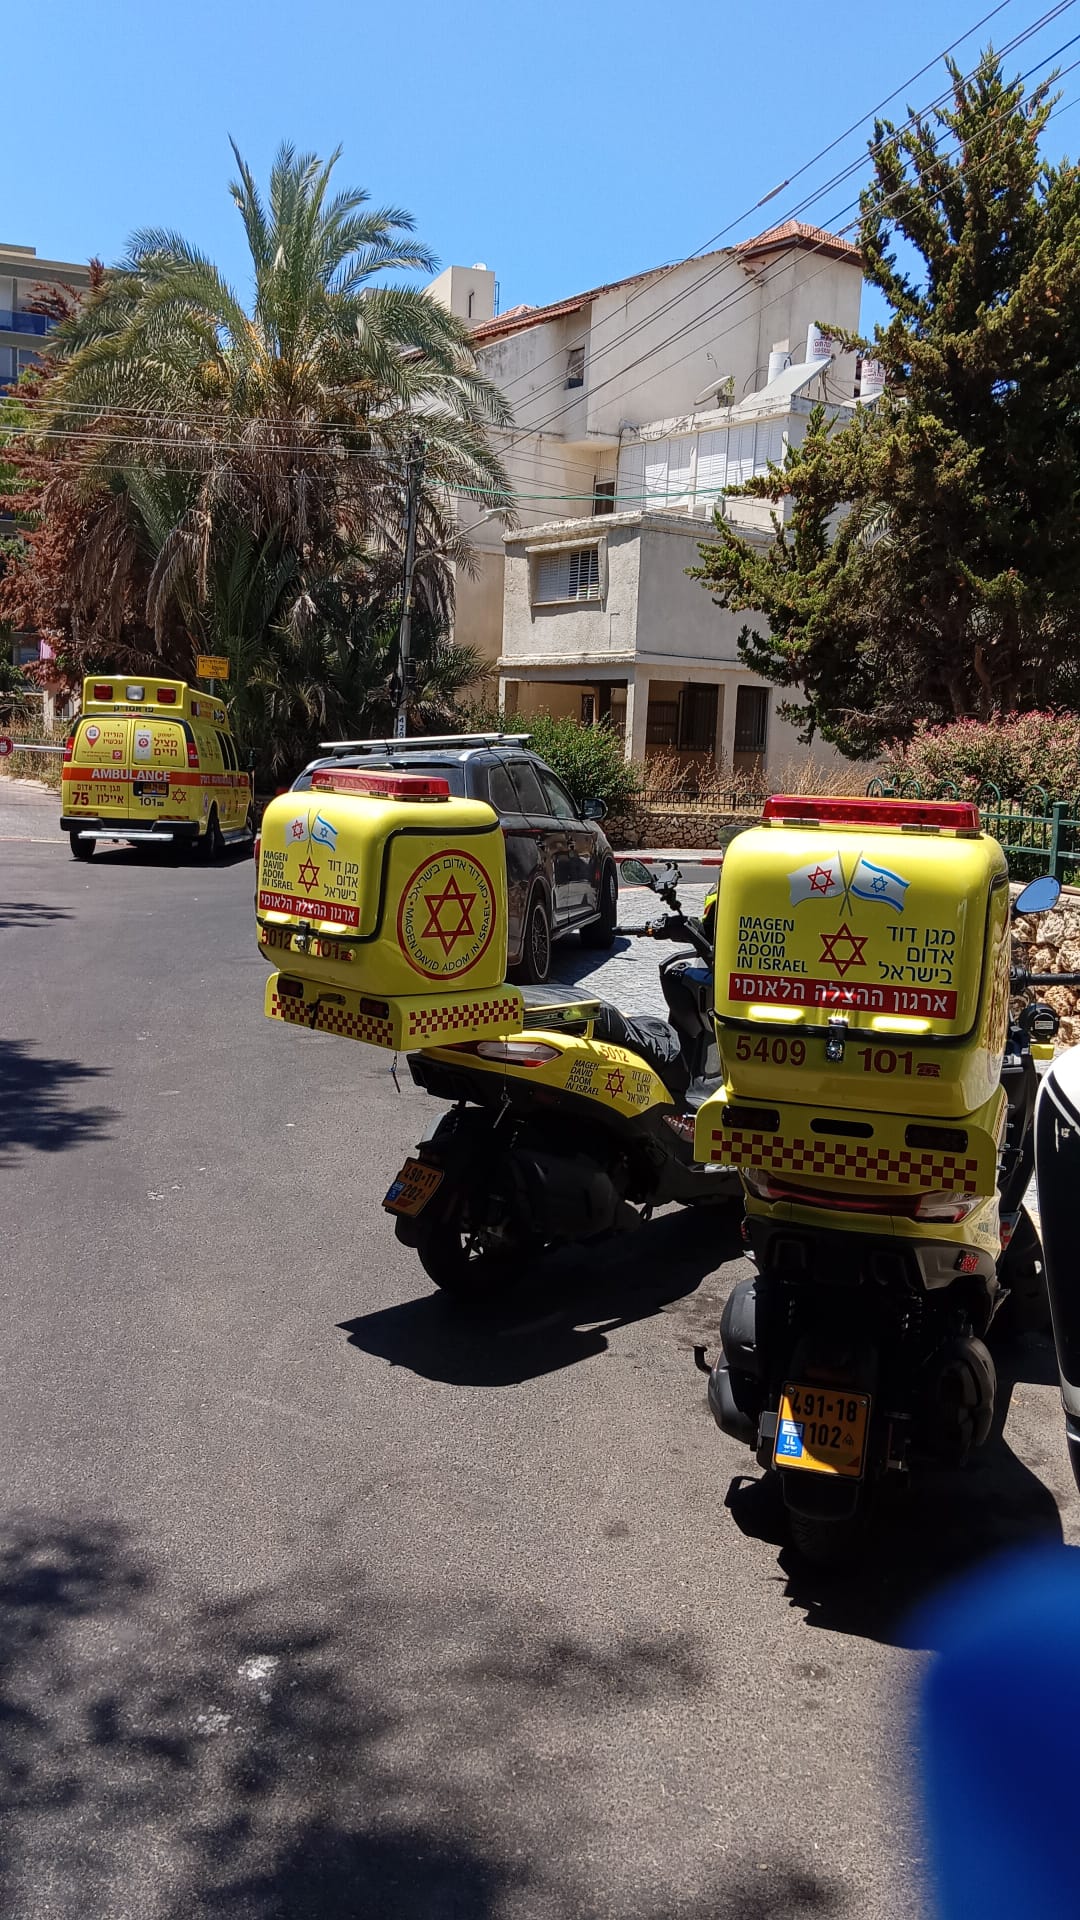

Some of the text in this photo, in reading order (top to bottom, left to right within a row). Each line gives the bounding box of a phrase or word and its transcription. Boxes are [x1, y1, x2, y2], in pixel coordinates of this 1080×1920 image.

[154, 737, 178, 747] מציל
[154, 748, 177, 756] חיים
[91, 768, 170, 781] AMBULANCE
[72, 791, 90, 805] 75
[97, 792, 124, 804] איילון
[139, 797, 156, 806] 101
[263, 850, 288, 861] MAGEN
[263, 859, 284, 870] DAVID
[328, 859, 359, 875] מגן דוד
[262, 869, 284, 880] ADOM
[336, 874, 359, 888] אדום
[408, 858, 488, 901] מגן דוד אדום בישראל
[262, 878, 294, 890] IN ISRAEL
[324, 883, 357, 901] בישראל
[261, 893, 355, 922] ארגון ההצלה הלאומי
[739, 916, 795, 932] MAGEN
[262, 927, 292, 950] 5012
[405, 904, 490, 971] MAGEN DAVID ADOM IN ISRAEL
[738, 929, 786, 944] DAVID
[886, 925, 956, 948] מגן דוד
[314, 938, 339, 960] 101
[738, 943, 785, 958] ADOM
[906, 946, 955, 965] אדום
[737, 957, 809, 973] IN ISRAEL
[878, 961, 953, 985] בישראל
[734, 976, 949, 1013] ארגון ההצלה הלאומי
[600, 1045, 630, 1063] 5012
[735, 1036, 806, 1066] 5409
[573, 1060, 599, 1071] MAGEN
[858, 1047, 914, 1075] 101
[570, 1067, 593, 1077] DAVID
[568, 1074, 591, 1086] ADOM
[565, 1082, 599, 1096] IN ISRAEL
[627, 1090, 650, 1105] בישראל
[792, 1392, 858, 1422] 491-18
[786, 1435, 795, 1445] IL
[809, 1422, 842, 1448] 102
